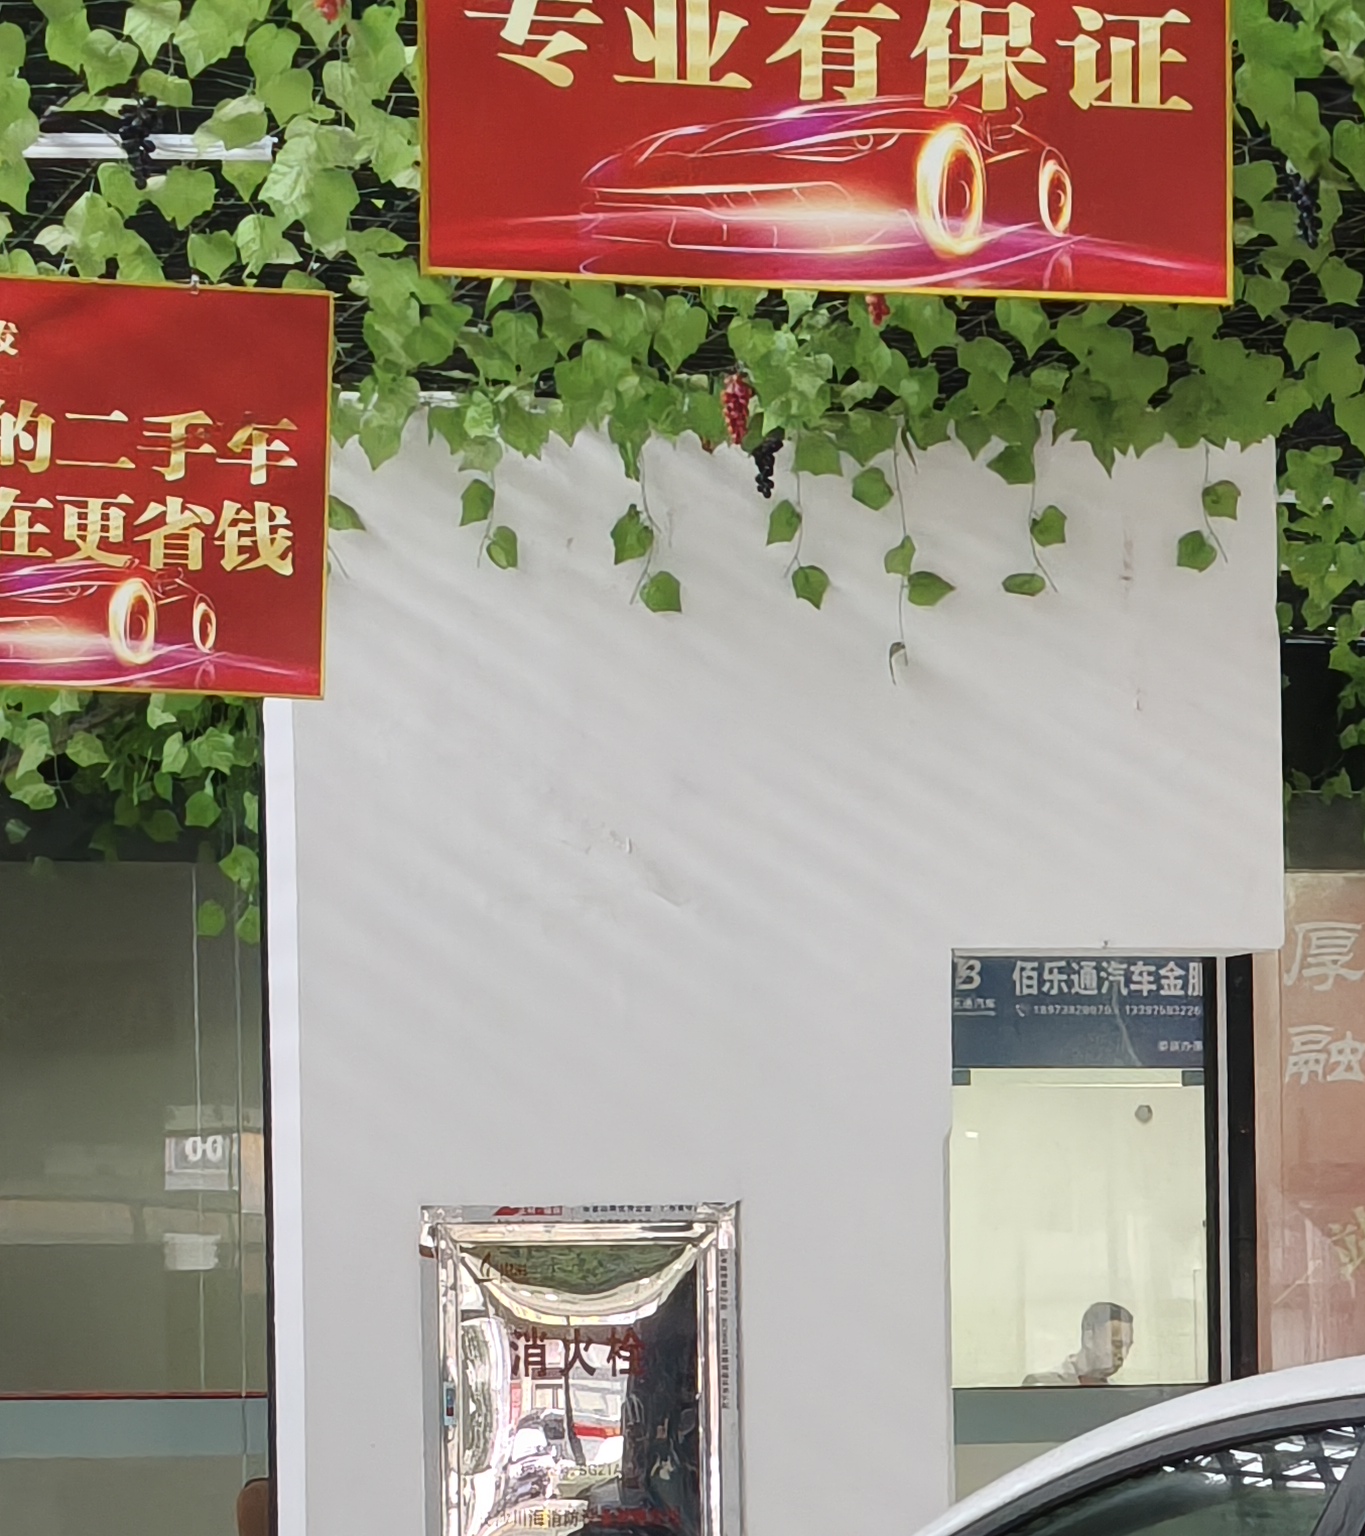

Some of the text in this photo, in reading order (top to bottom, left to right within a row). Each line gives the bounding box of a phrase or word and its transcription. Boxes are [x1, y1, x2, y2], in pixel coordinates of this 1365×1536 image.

[465, 0, 1194, 111] 专业有保证
[0, 486, 294, 576] 在更省钱
[509, 1326, 646, 1378] 消火栓
